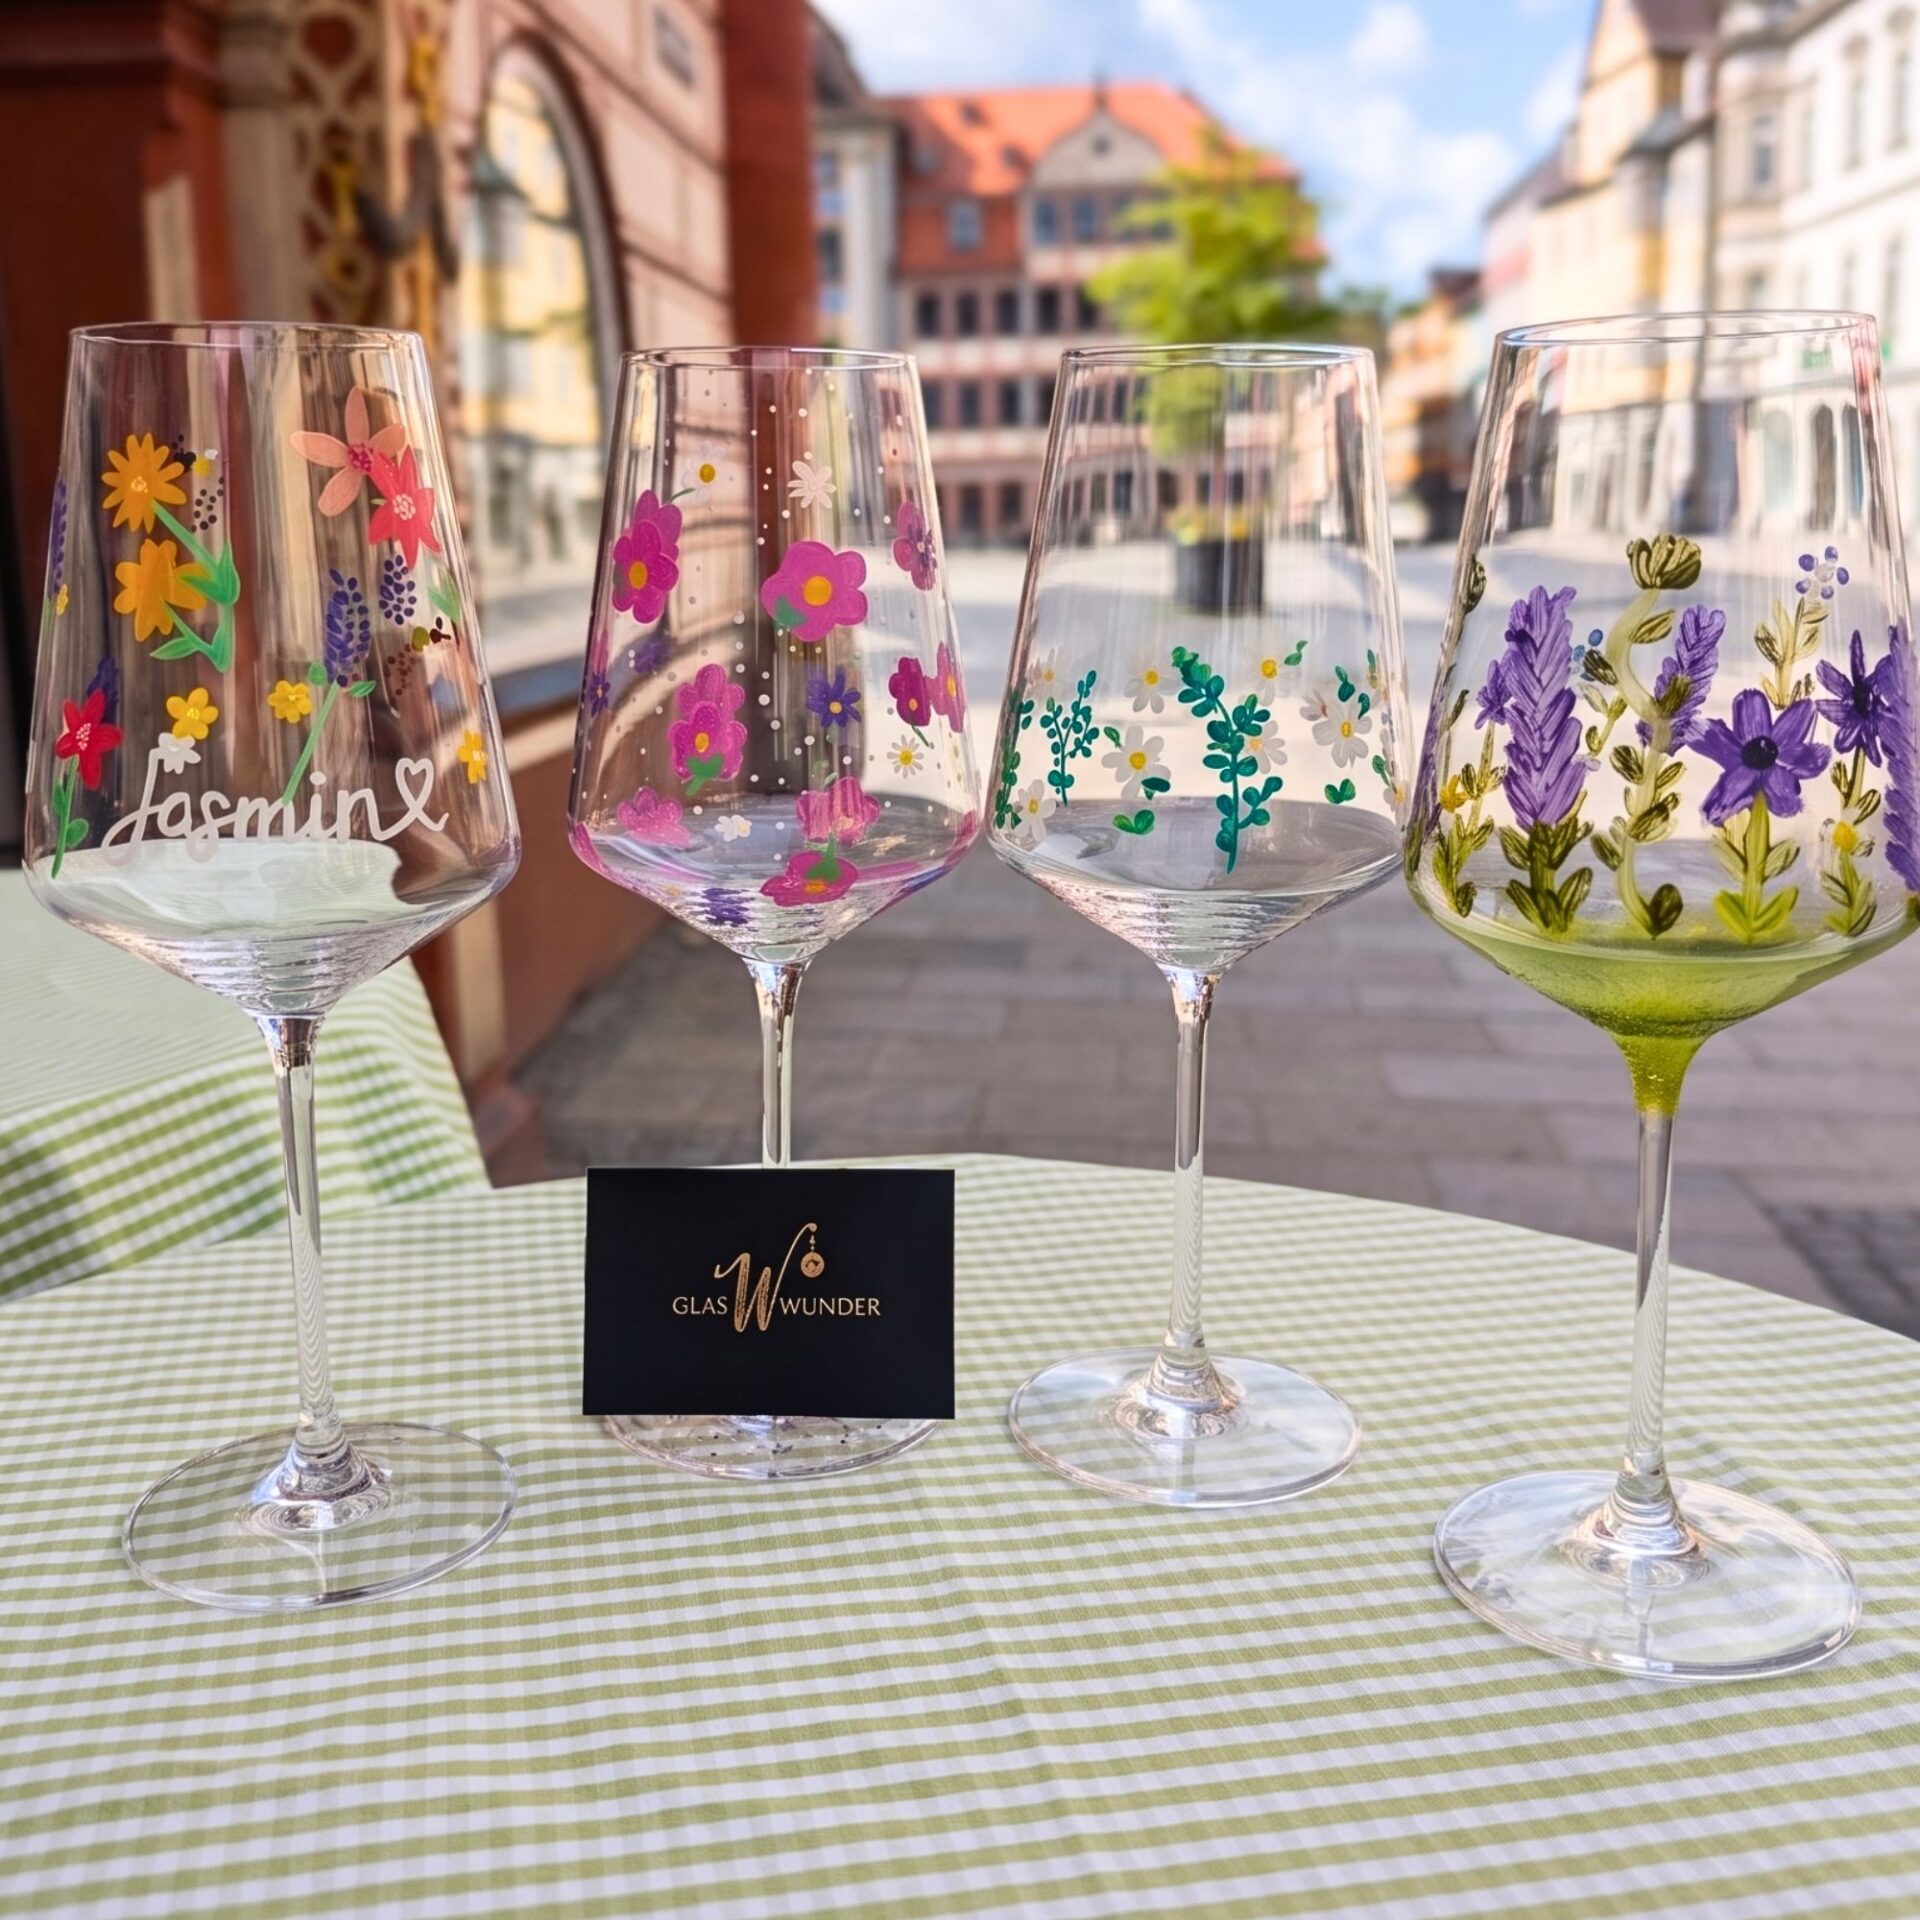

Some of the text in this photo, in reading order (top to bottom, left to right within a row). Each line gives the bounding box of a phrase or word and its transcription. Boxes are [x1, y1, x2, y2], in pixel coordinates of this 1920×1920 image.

[101, 748, 386, 867] Jasmin
[672, 1296, 882, 1316] GLAS WUNDER
